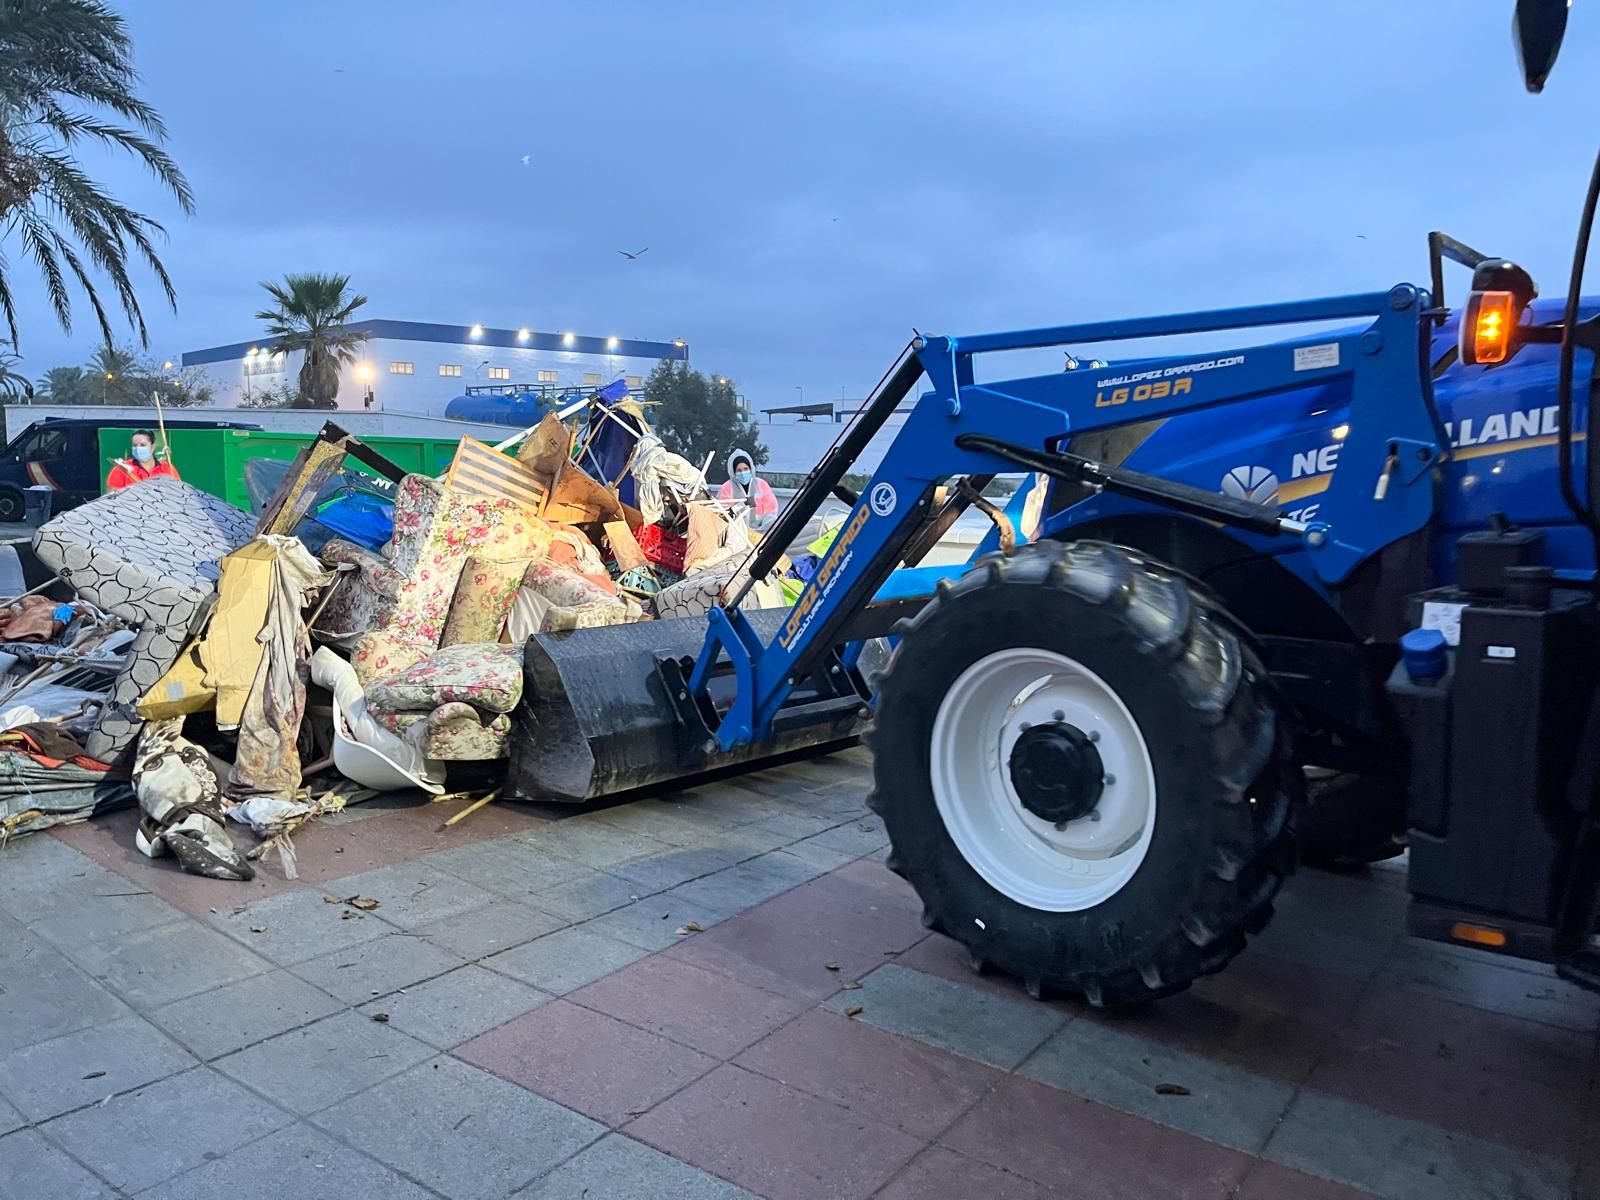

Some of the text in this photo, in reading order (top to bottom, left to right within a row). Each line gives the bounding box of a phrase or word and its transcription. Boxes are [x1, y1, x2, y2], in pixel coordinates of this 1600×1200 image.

[1095, 388, 1130, 408] LG
[1291, 443, 1344, 478] NE
[779, 504, 871, 648] LOPEZ GARRIDO
